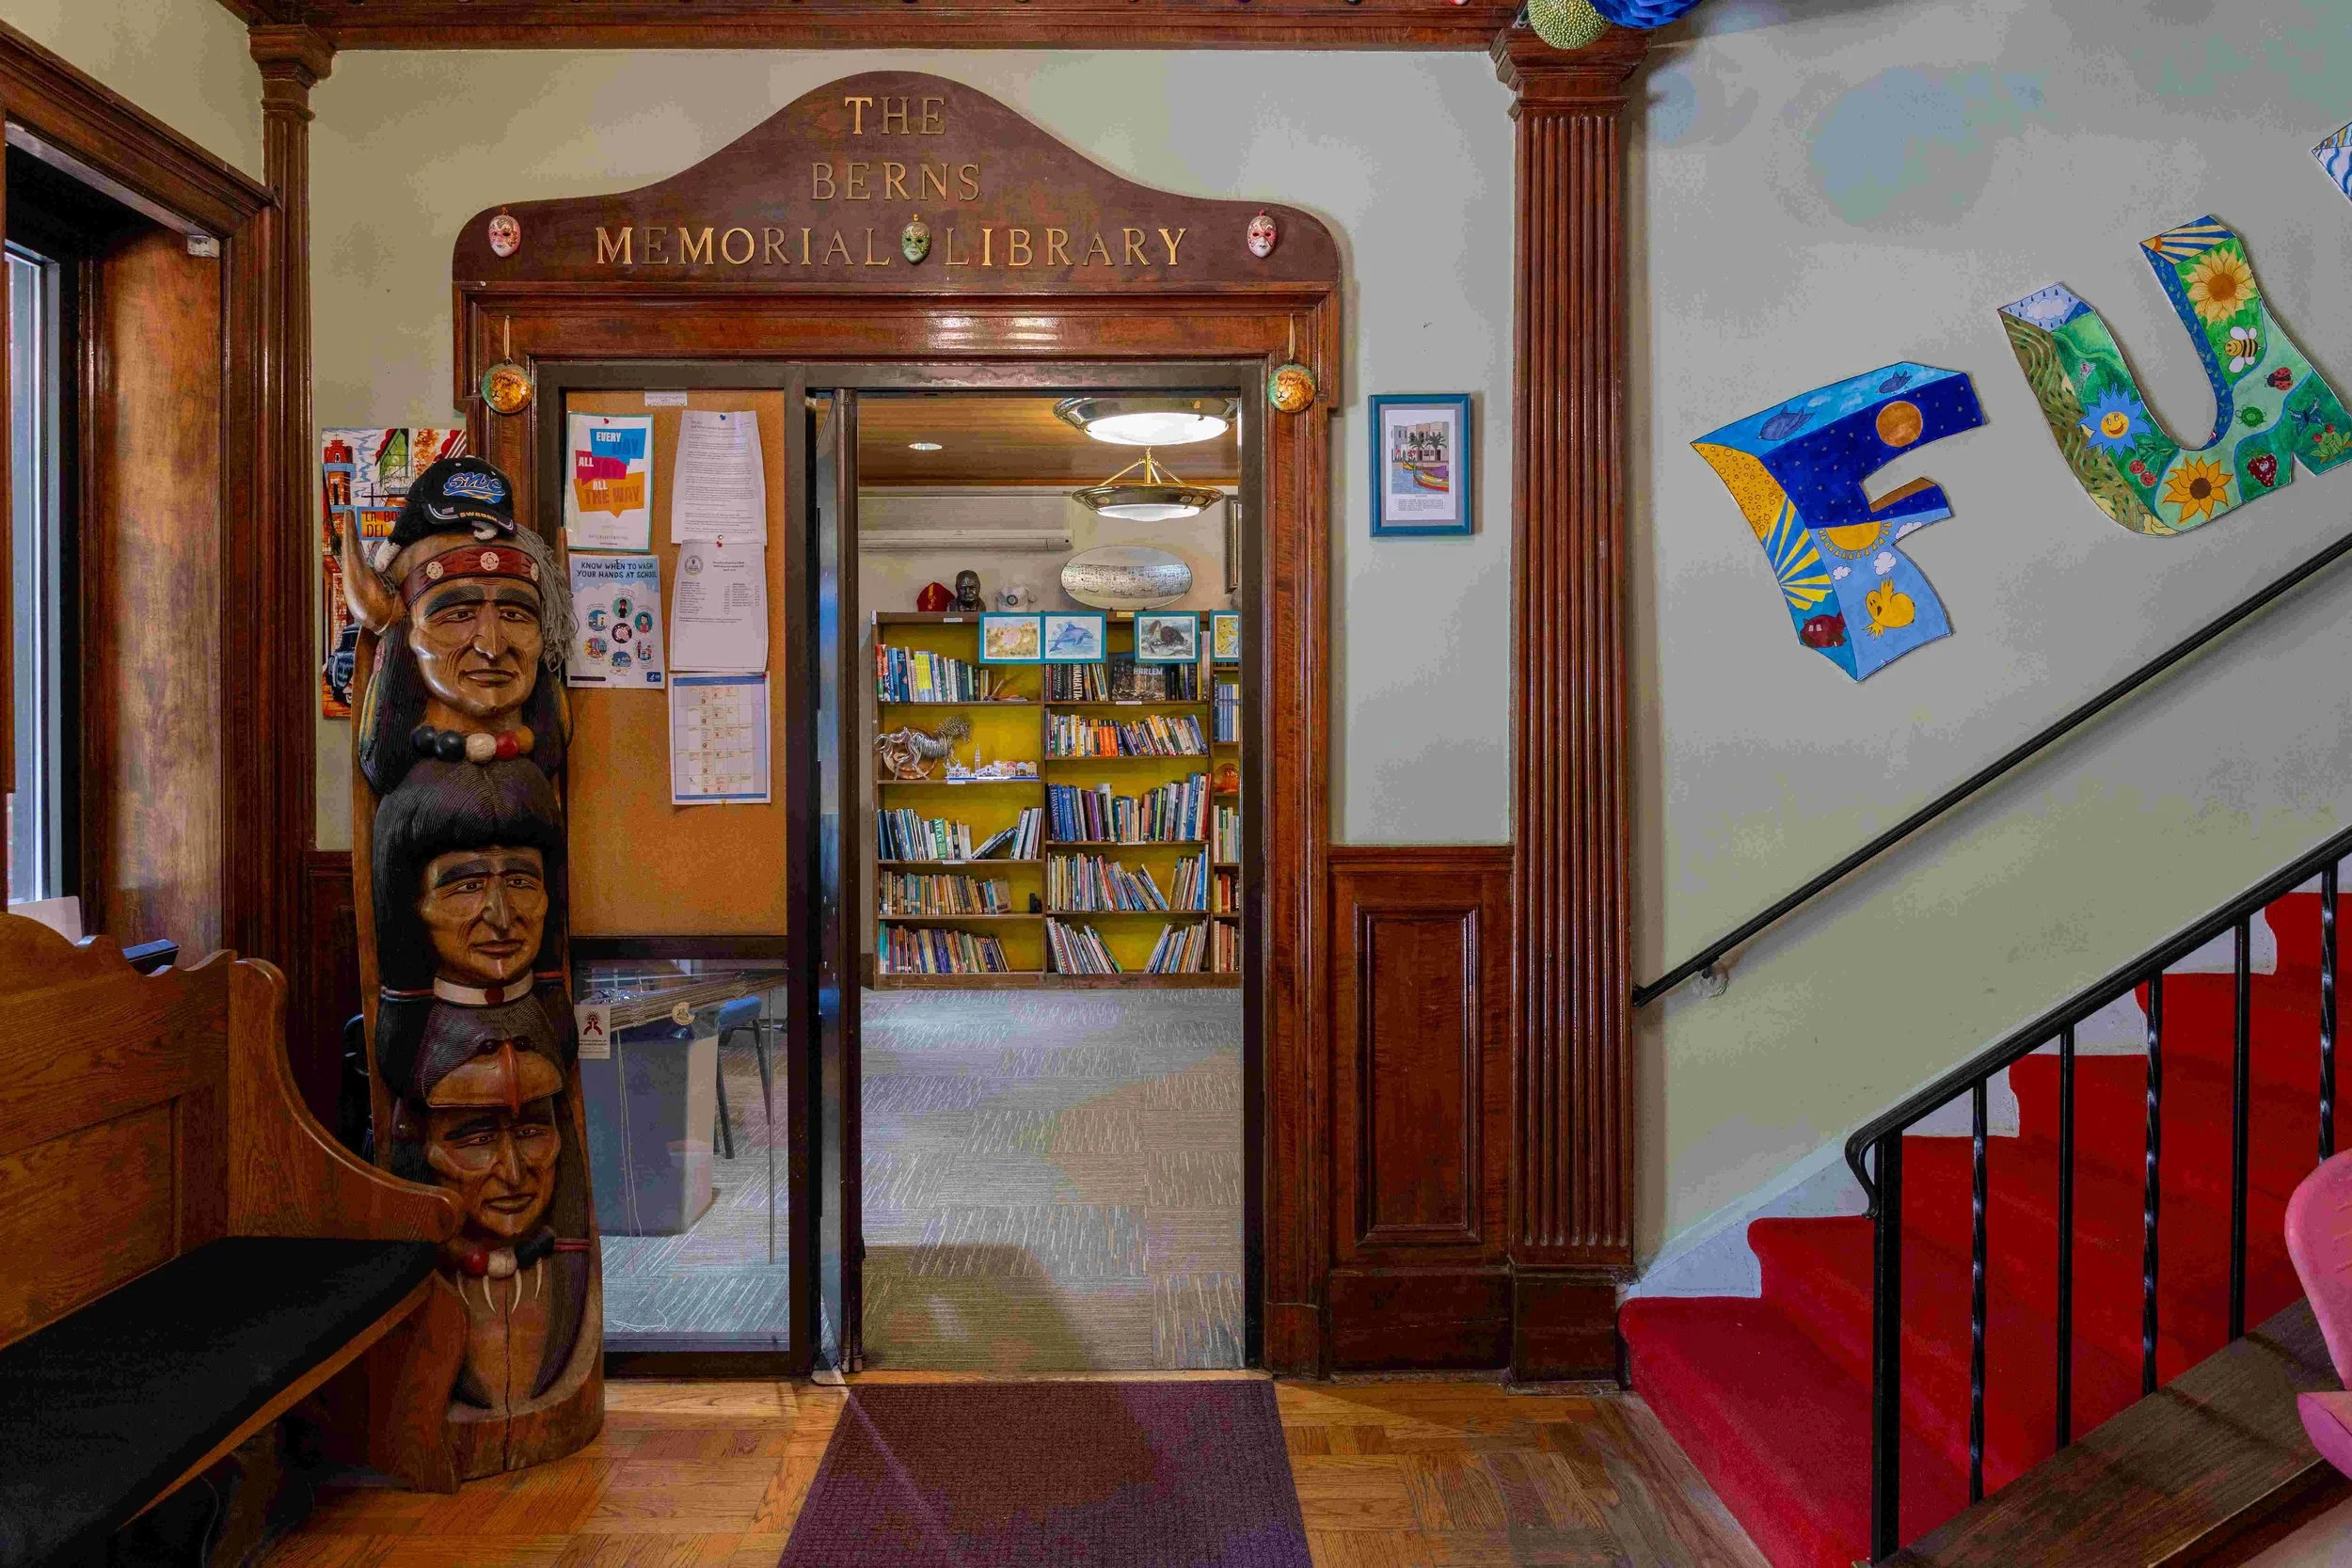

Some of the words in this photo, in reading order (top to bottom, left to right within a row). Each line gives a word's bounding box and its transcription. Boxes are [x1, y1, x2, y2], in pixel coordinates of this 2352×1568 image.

[843, 95, 946, 136] THE
[810, 161, 982, 201] BERNS
[595, 225, 892, 267] MEMORIAL
[944, 225, 1190, 267] LIBRARY
[596, 431, 622, 442] EVERY
[612, 437, 639, 455] DAY
[578, 456, 595, 467] ALL
[584, 489, 610, 505] THE
[612, 486, 640, 503] WAY
[593, 480, 609, 491] ALL
[365, 511, 376, 522] LA
[384, 511, 400, 522] BO
[580, 562, 602, 570] KNOW
[1133, 667, 1164, 675] HARLEM
[1051, 789, 1059, 816] HAVANA
[934, 818, 943, 843] ATLAS
